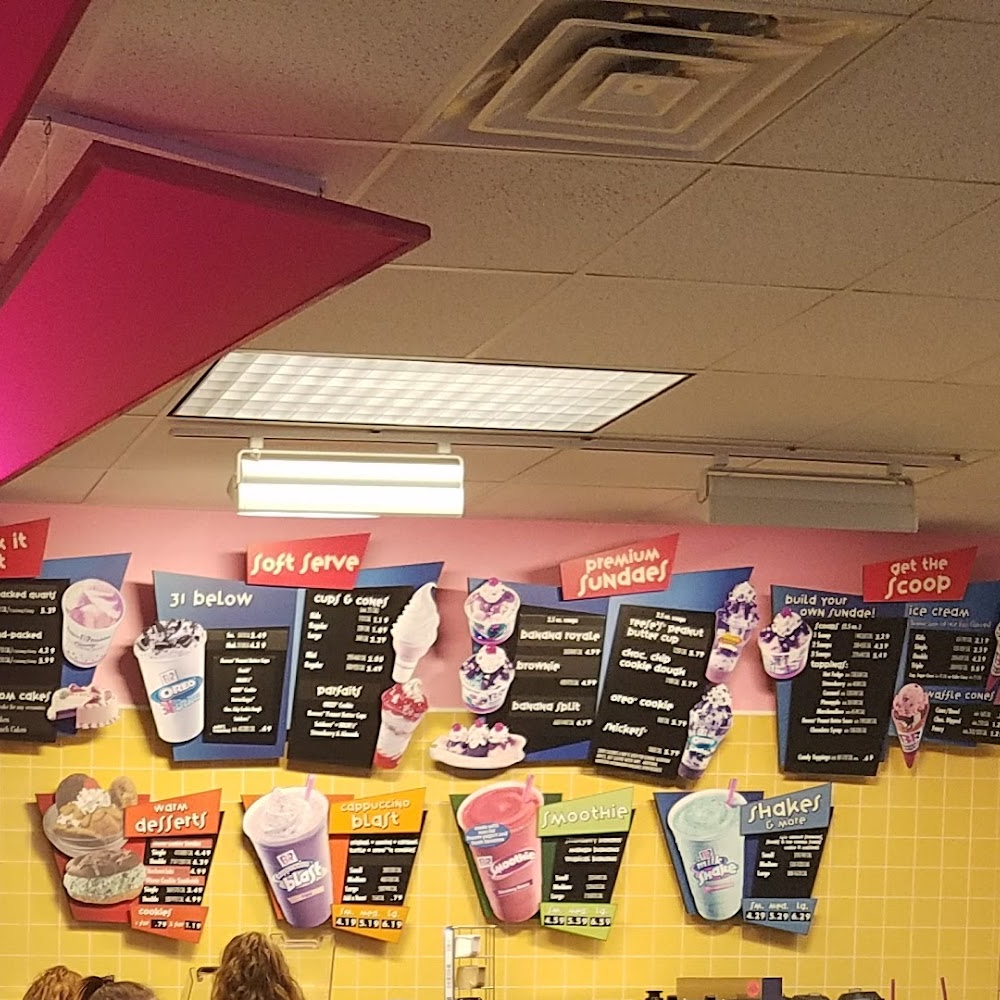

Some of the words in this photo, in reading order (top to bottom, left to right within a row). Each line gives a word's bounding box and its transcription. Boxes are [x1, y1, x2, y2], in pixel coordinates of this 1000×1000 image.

[12, 532, 28, 550] it
[890, 559, 917, 577] get
[170, 592, 185, 608] 31
[785, 594, 817, 605] build
[821, 596, 848, 606] your
[908, 605, 927, 617] ice
